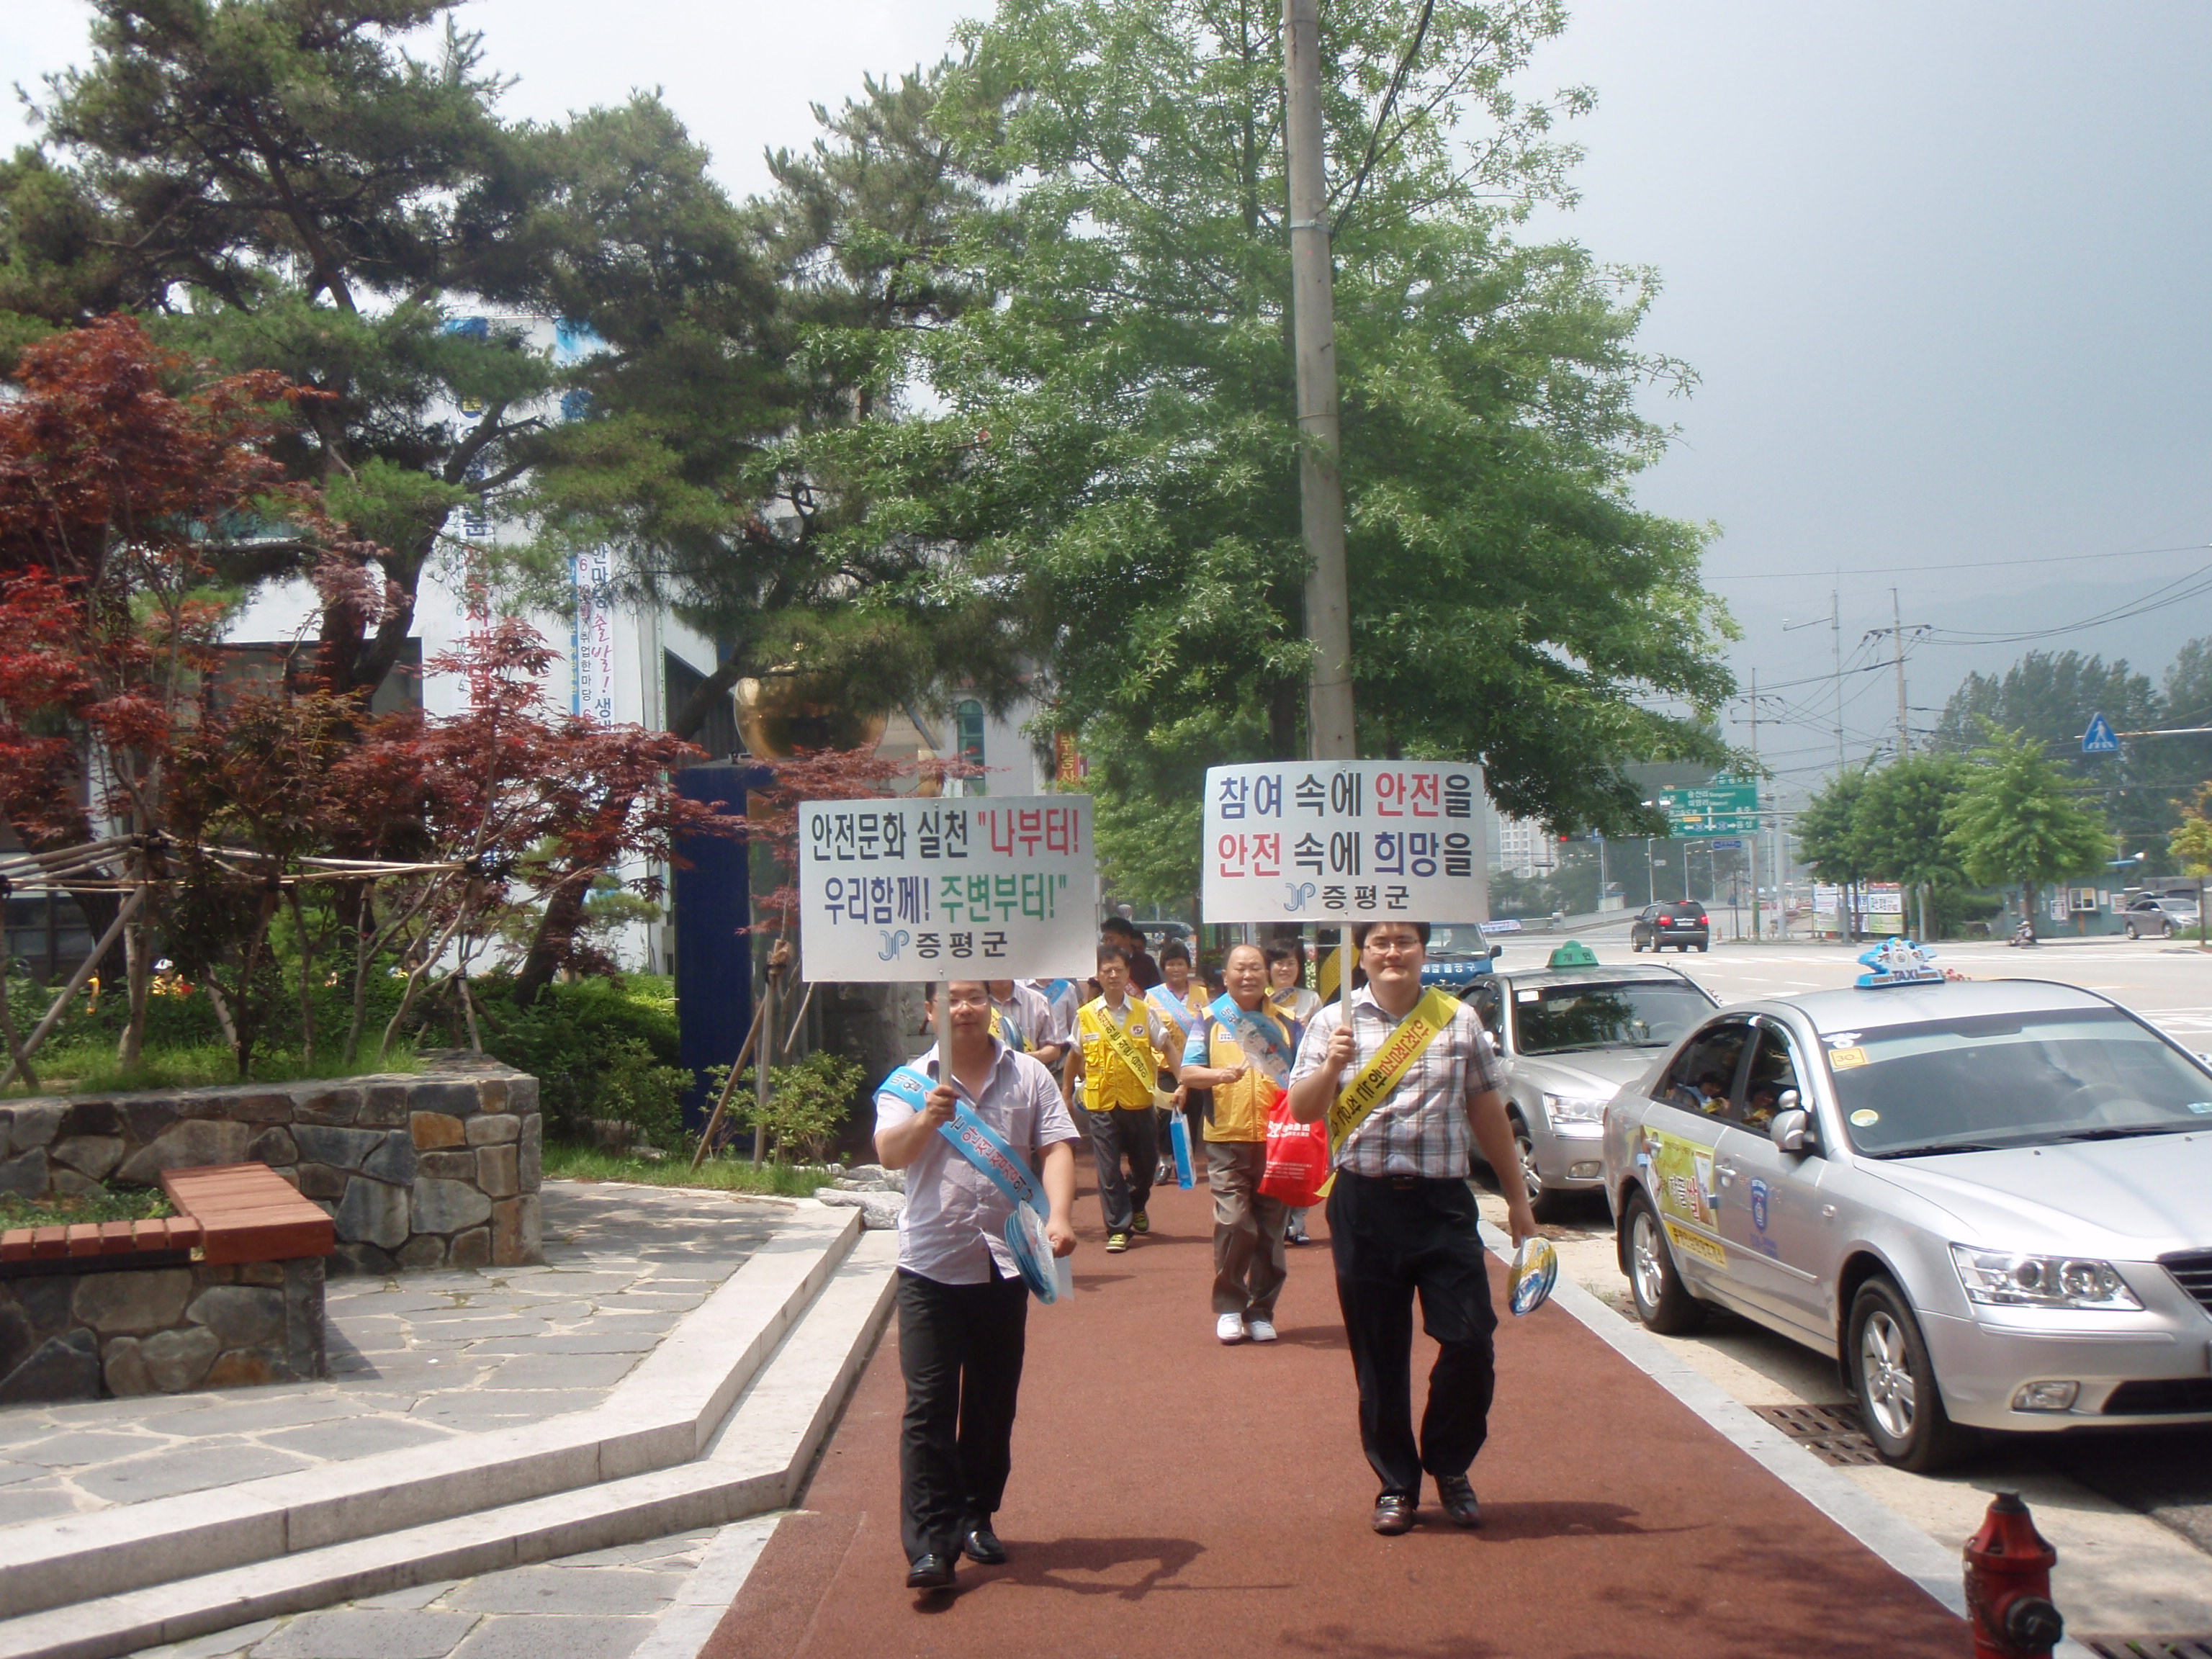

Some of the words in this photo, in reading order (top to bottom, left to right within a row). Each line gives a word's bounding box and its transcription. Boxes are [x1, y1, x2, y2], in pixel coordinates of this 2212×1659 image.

[580, 631, 593, 703] 취업한마당
[591, 613, 612, 693] 출발!
[1218, 774, 1282, 819] 참여
[1295, 773, 1362, 817] 속에
[1375, 772, 1472, 819] 안전을
[811, 811, 906, 861] 안전문화
[917, 811, 968, 859] 실천
[977, 809, 1079, 858] "나부터!
[1218, 832, 1281, 878] 안전
[1294, 832, 1361, 876] 속에
[1375, 832, 1473, 878] 희망을
[824, 876, 930, 925] 우리함께!
[940, 873, 1068, 923] 주변부터!"
[1322, 885, 1410, 910] 증평군
[915, 931, 1008, 958] 증평군
[1892, 968, 1920, 981] TAXI
[1356, 1019, 1430, 1102] 안전점검하는
[889, 1073, 923, 1093] 매월
[962, 1125, 1027, 1192] 안전점검의
[1336, 1095, 1362, 1127] 작은
